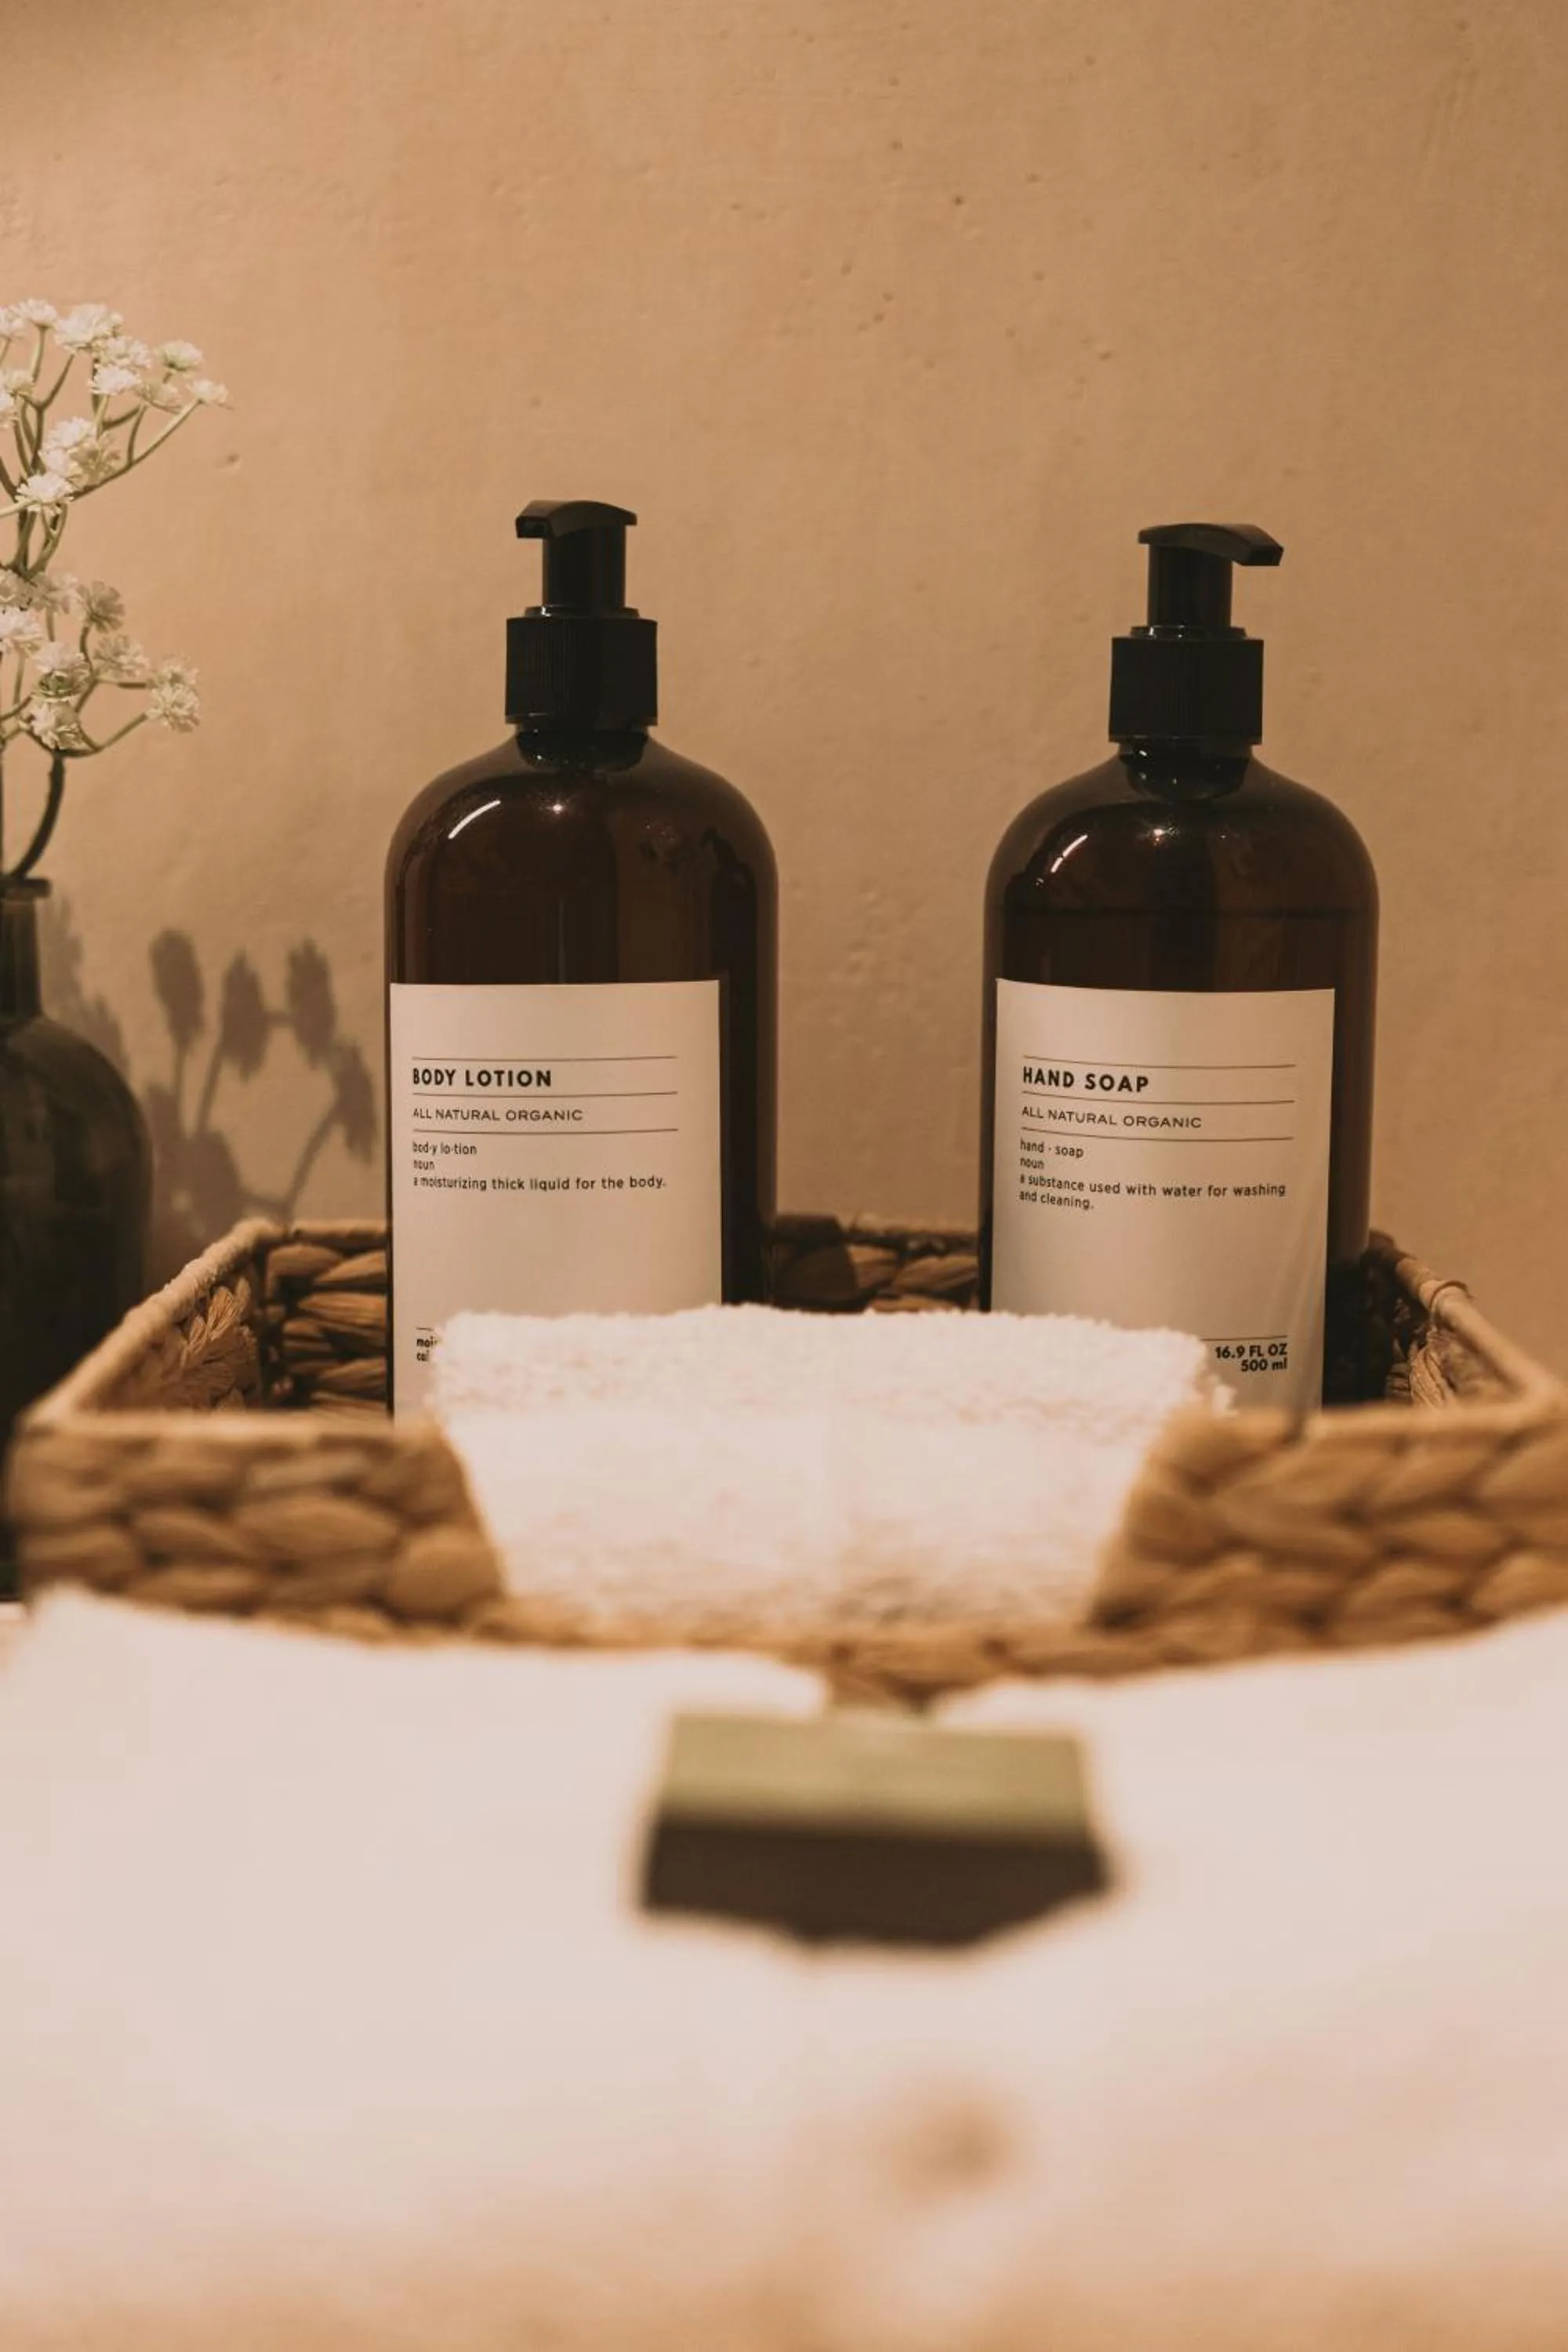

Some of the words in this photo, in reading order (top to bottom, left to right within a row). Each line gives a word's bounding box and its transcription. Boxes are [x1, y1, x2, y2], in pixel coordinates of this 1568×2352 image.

[413, 1069, 456, 1085] BODY
[466, 1069, 551, 1087] LOTION
[1023, 1066, 1075, 1087] HAND
[1085, 1073, 1149, 1092] SOAP
[413, 1109, 432, 1119] ALL
[435, 1109, 500, 1120] NATURAL
[506, 1110, 583, 1121] ORGANIC
[1022, 1106, 1044, 1119] ALL
[1048, 1110, 1117, 1125] NATURAL
[1123, 1116, 1202, 1128] ORGANIC
[1020, 1140, 1044, 1153] hand
[1055, 1146, 1083, 1159] soap
[413, 1160, 435, 1171] noun
[1020, 1158, 1044, 1169] noun
[420, 1177, 487, 1191] moisturizing
[492, 1178, 524, 1190] thick
[530, 1178, 569, 1192] liquid
[576, 1178, 595, 1189] for
[601, 1178, 623, 1189] the
[630, 1176, 666, 1189] body.
[1028, 1175, 1085, 1192] substance
[1090, 1182, 1120, 1194] used
[1127, 1183, 1156, 1196] with
[1163, 1185, 1202, 1196] water
[1208, 1185, 1227, 1196] for
[1233, 1184, 1286, 1196] washing
[1019, 1190, 1036, 1203] and
[1041, 1193, 1094, 1210] cleaning.
[1215, 1346, 1245, 1358] 16.9
[1249, 1345, 1264, 1356] FL
[1269, 1343, 1287, 1356] OZ
[1241, 1359, 1268, 1372] 500
[1272, 1358, 1287, 1370] ml
